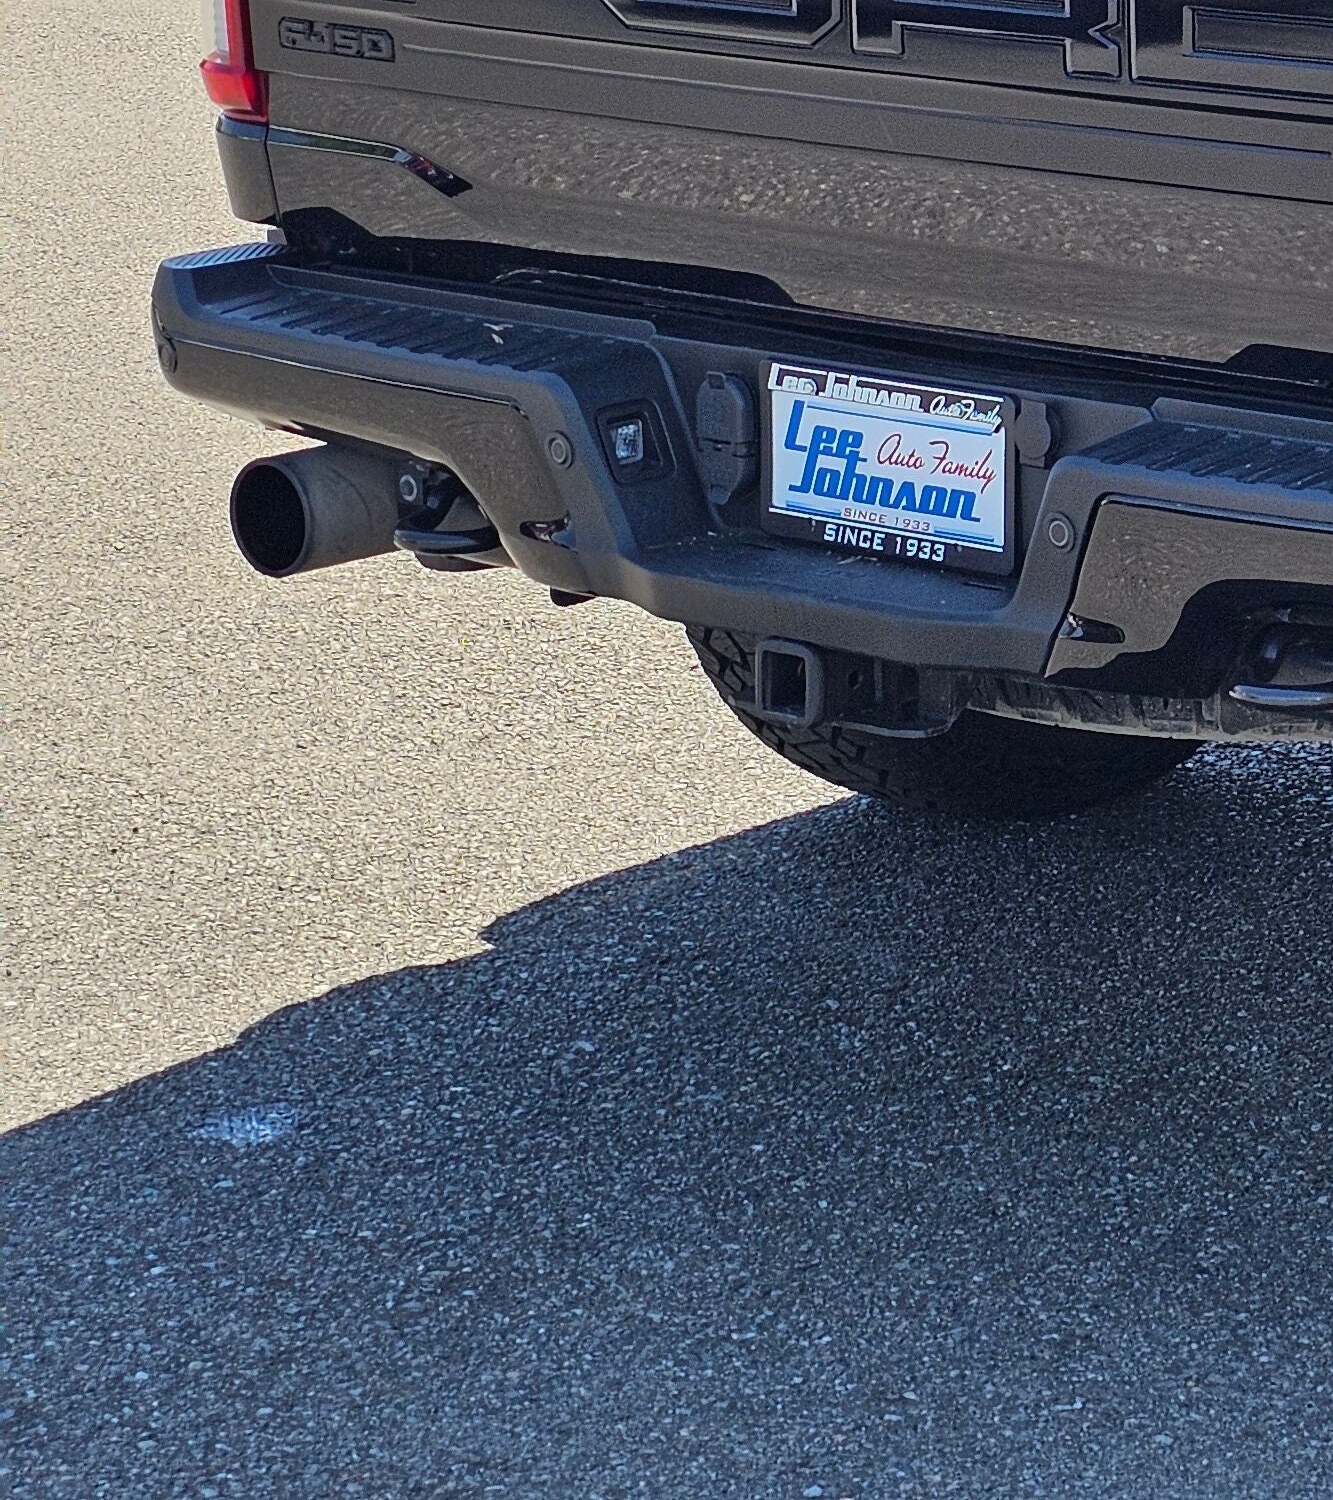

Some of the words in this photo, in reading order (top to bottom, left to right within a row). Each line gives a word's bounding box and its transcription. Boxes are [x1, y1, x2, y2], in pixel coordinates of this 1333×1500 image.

[784, 399, 867, 460] Lee
[788, 448, 982, 522] Johnson
[877, 433, 925, 469] Auto
[929, 440, 997, 494] Family
[823, 523, 886, 551] SINCE
[895, 536, 945, 562] 1933
[843, 507, 888, 524] SINCE
[895, 516, 931, 532] 1933
